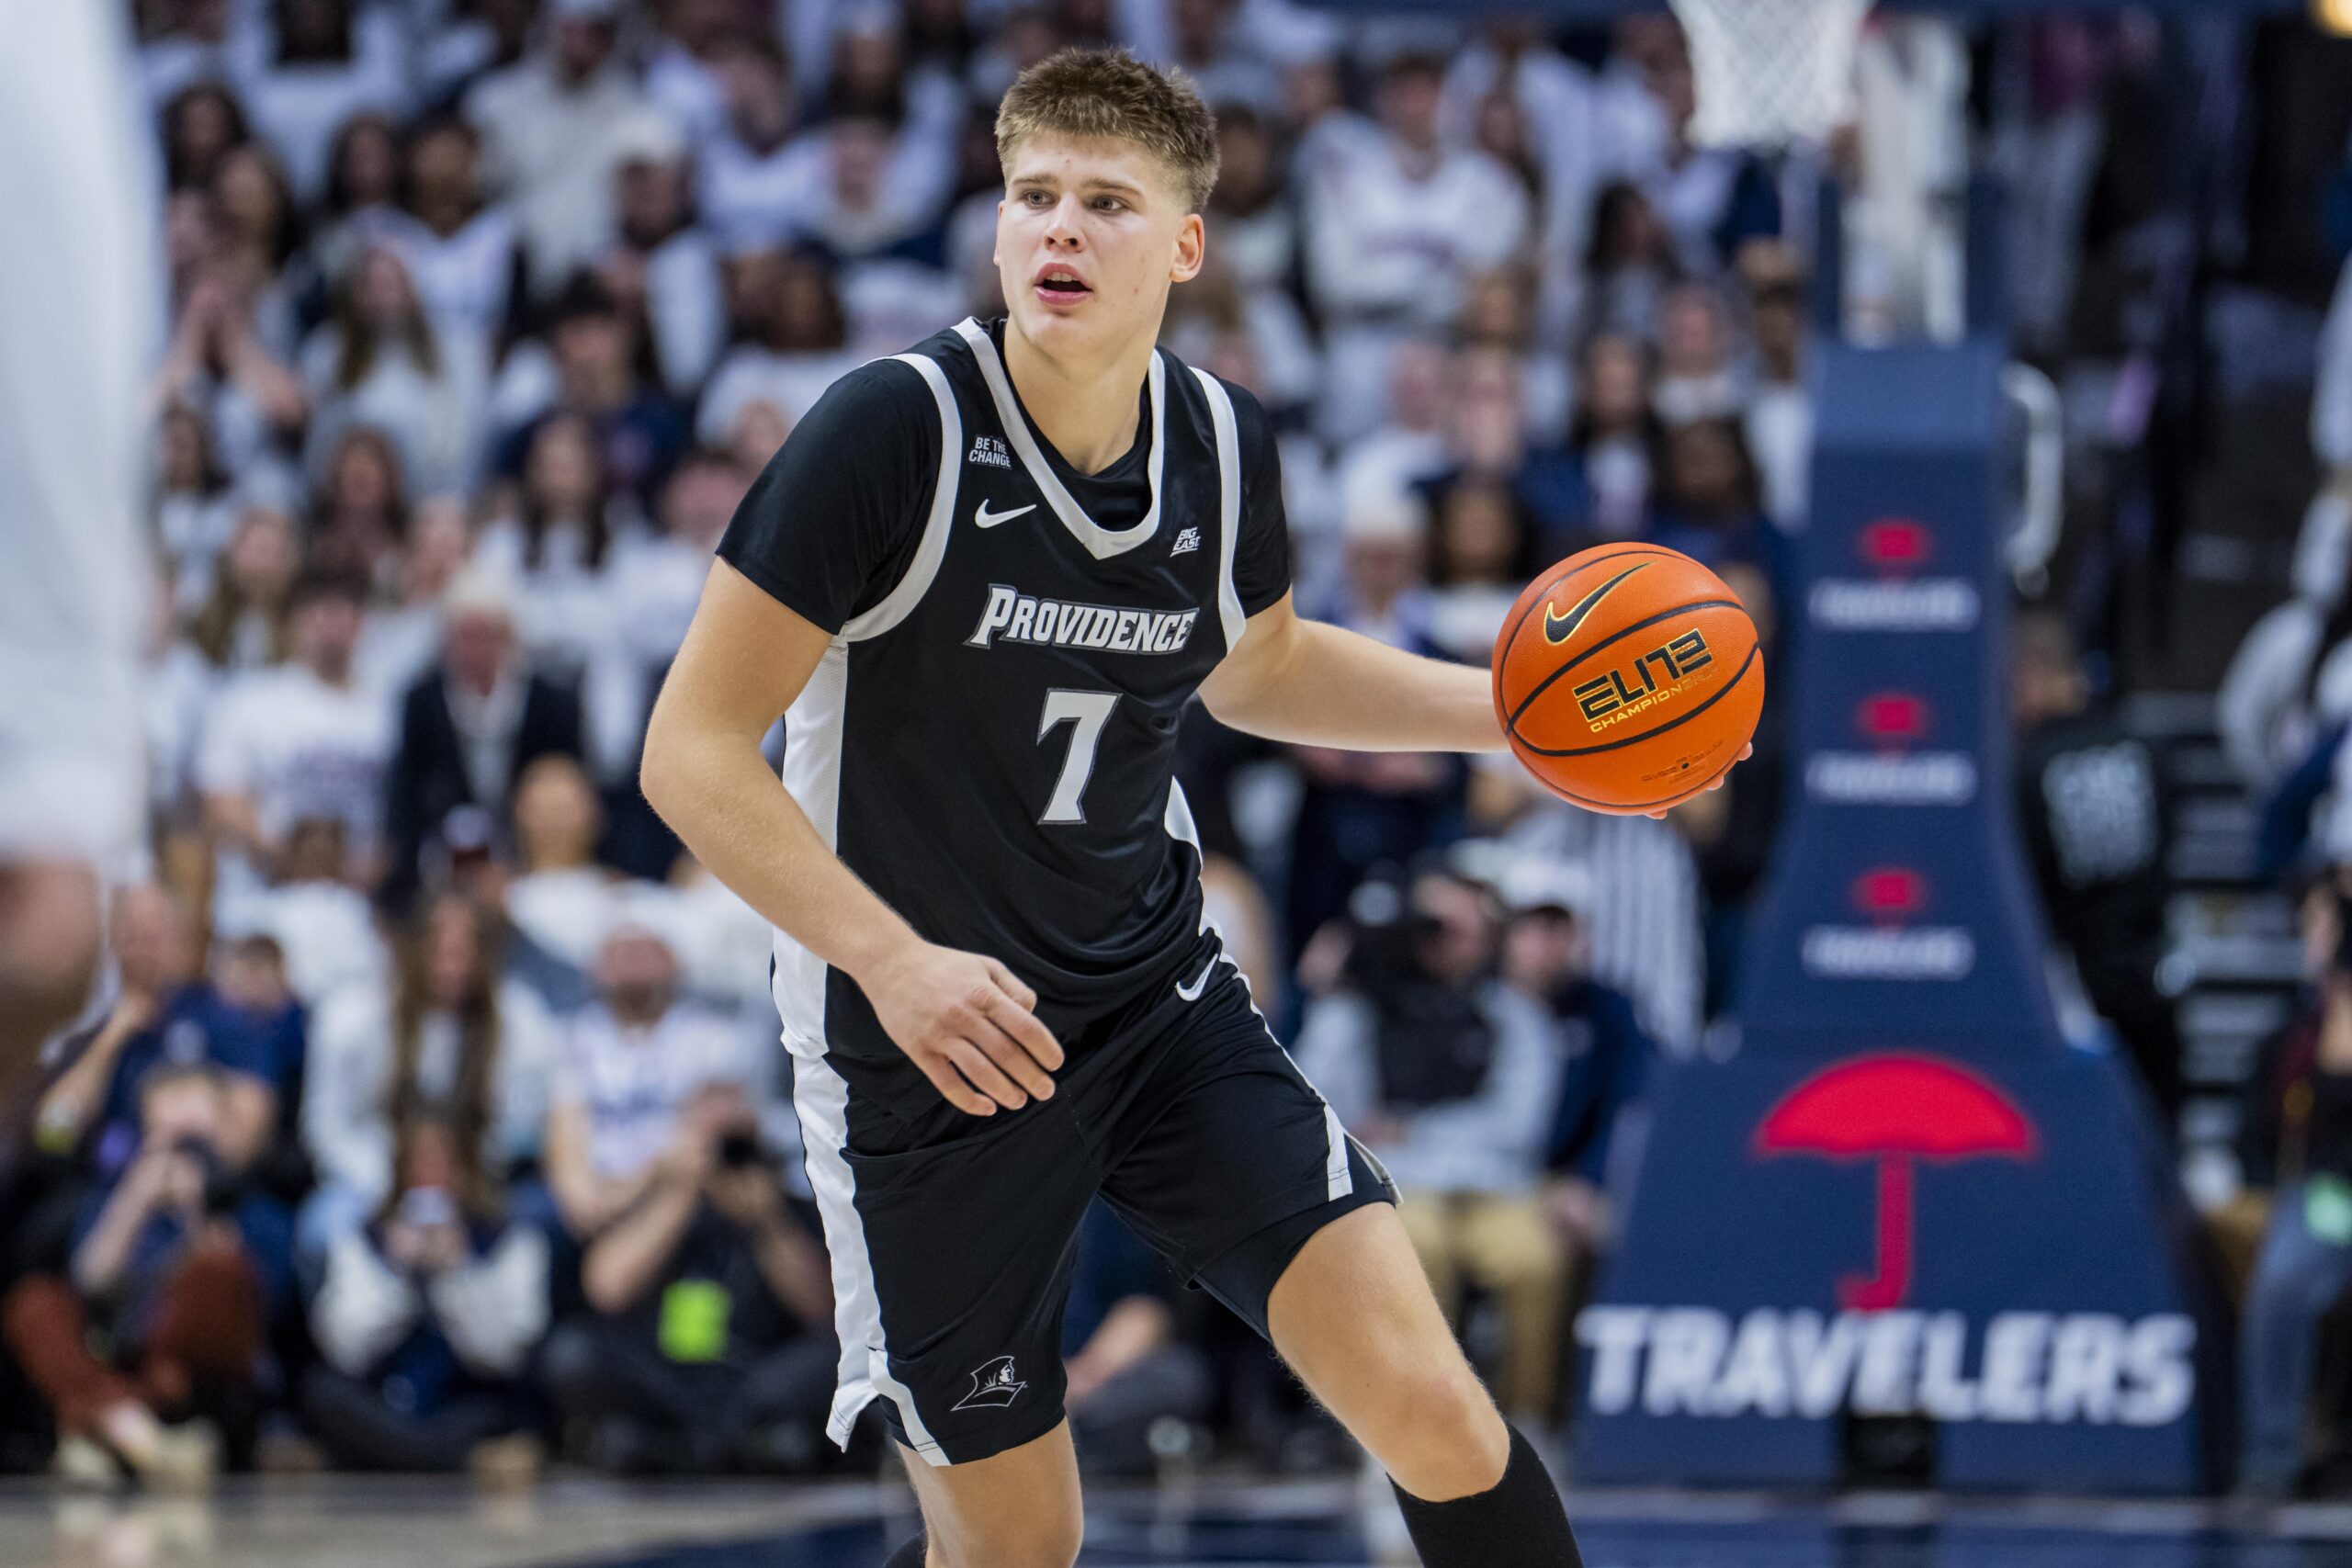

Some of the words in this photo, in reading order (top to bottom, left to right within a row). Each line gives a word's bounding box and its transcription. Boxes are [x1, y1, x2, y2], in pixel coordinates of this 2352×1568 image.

[968, 449, 1012, 468] CHANGE
[975, 436, 990, 450] BE
[992, 439, 1007, 455] THE
[1172, 536, 1201, 551] EAST
[1177, 526, 1198, 541] BIG
[963, 582, 1200, 655] PROVIDENCE
[1572, 627, 1713, 723] ELITE
[1589, 665, 1717, 733] CHAMPION
[1036, 687, 1124, 825] 7
[1573, 1304, 2197, 1427] TRAVELERS
